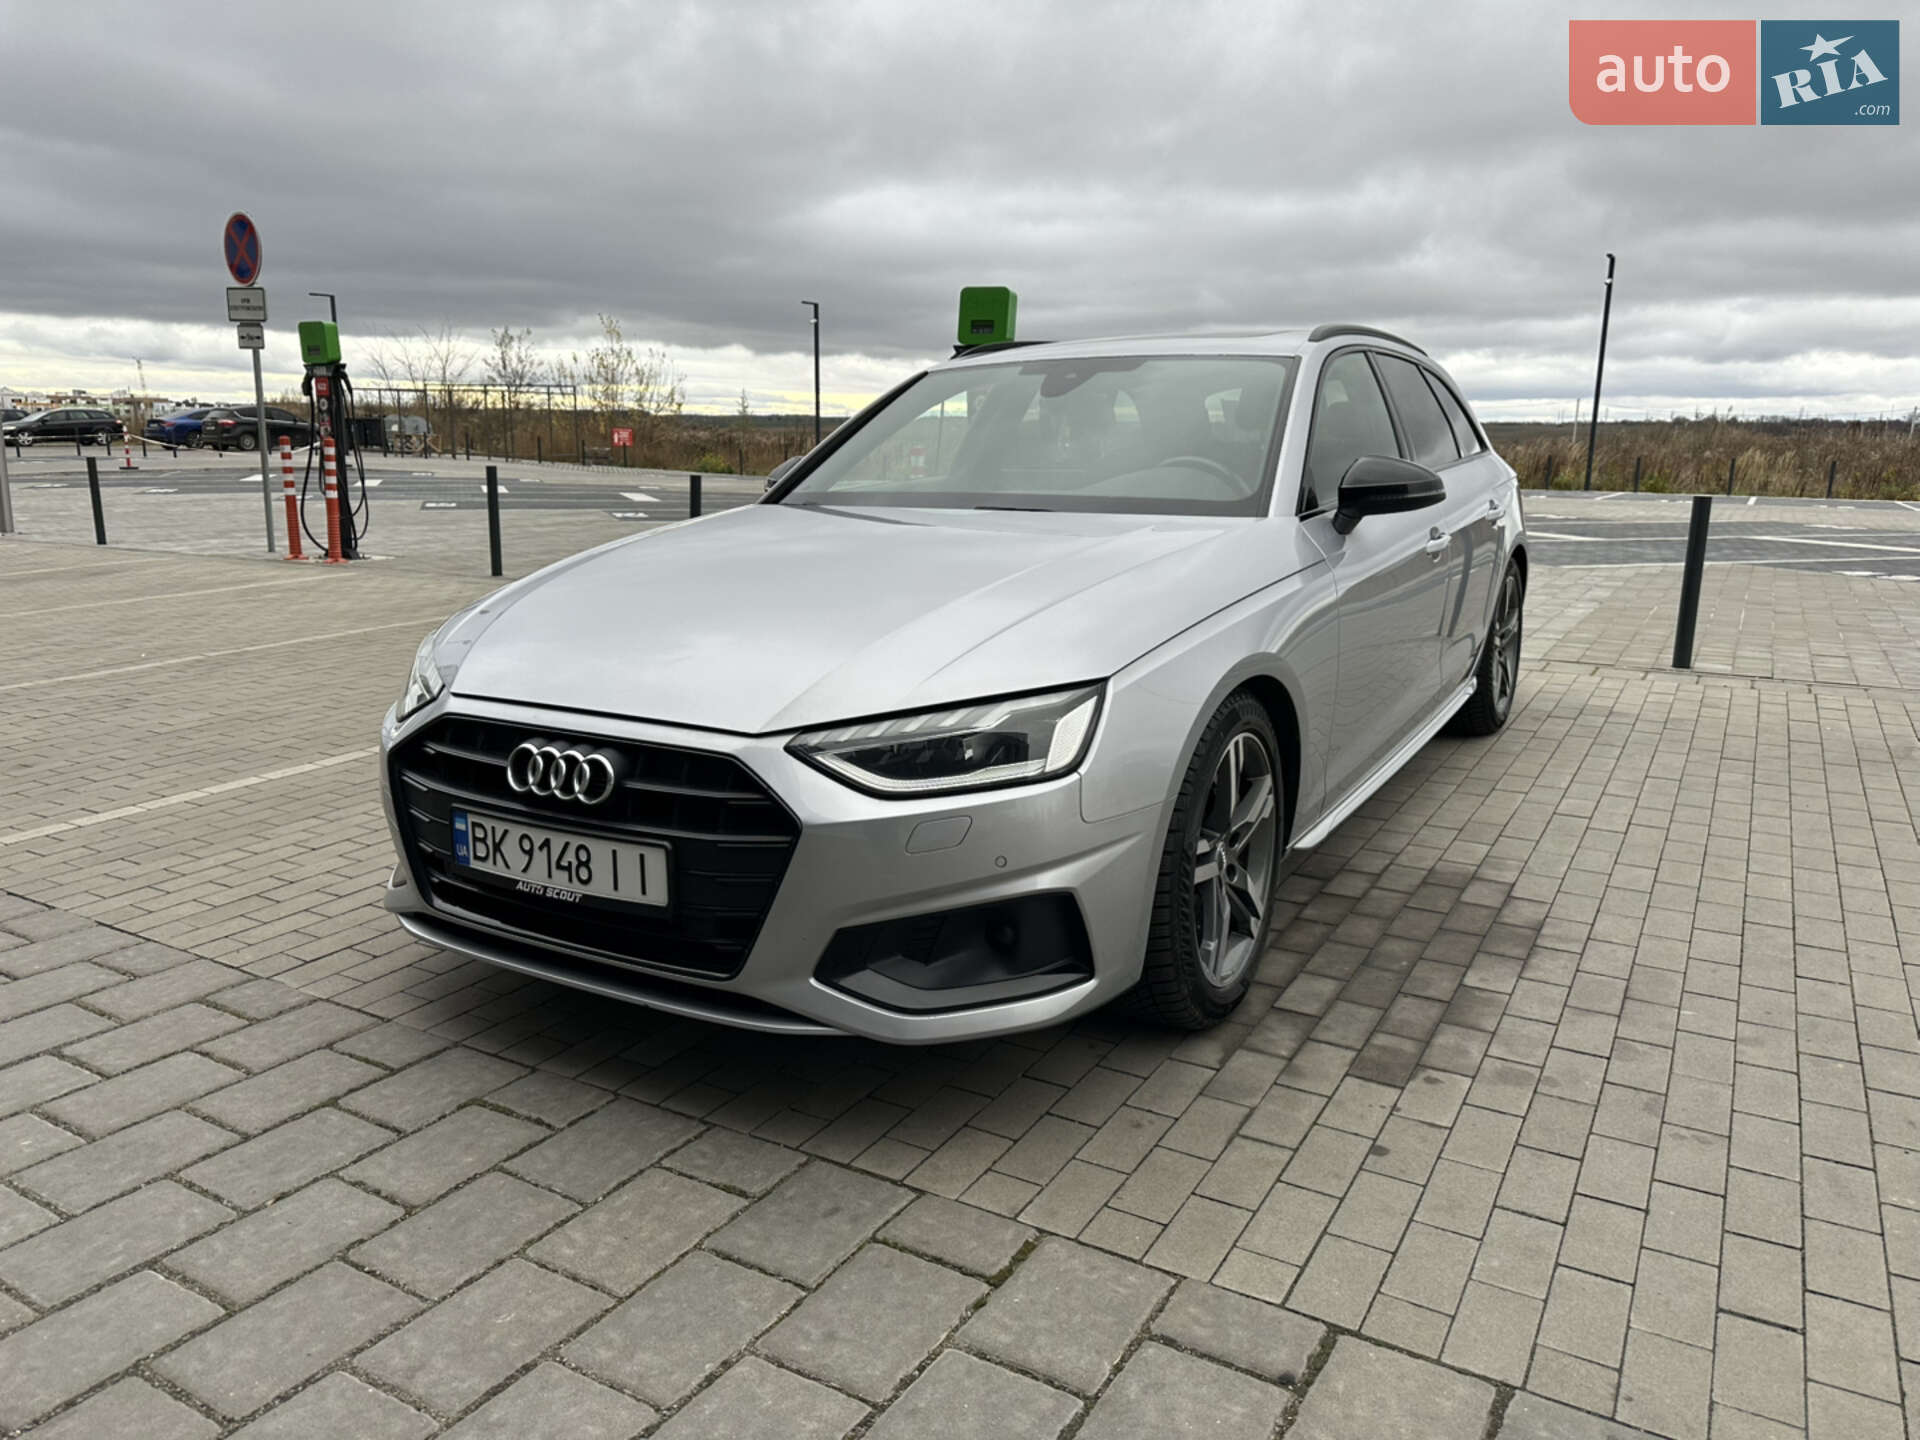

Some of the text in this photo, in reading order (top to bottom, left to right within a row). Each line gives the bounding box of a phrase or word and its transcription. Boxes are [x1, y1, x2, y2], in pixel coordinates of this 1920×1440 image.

[456, 843, 468, 857] UA
[471, 820, 511, 871] BK
[518, 832, 593, 886] 9148
[515, 880, 583, 904] AUTO SCOUT
